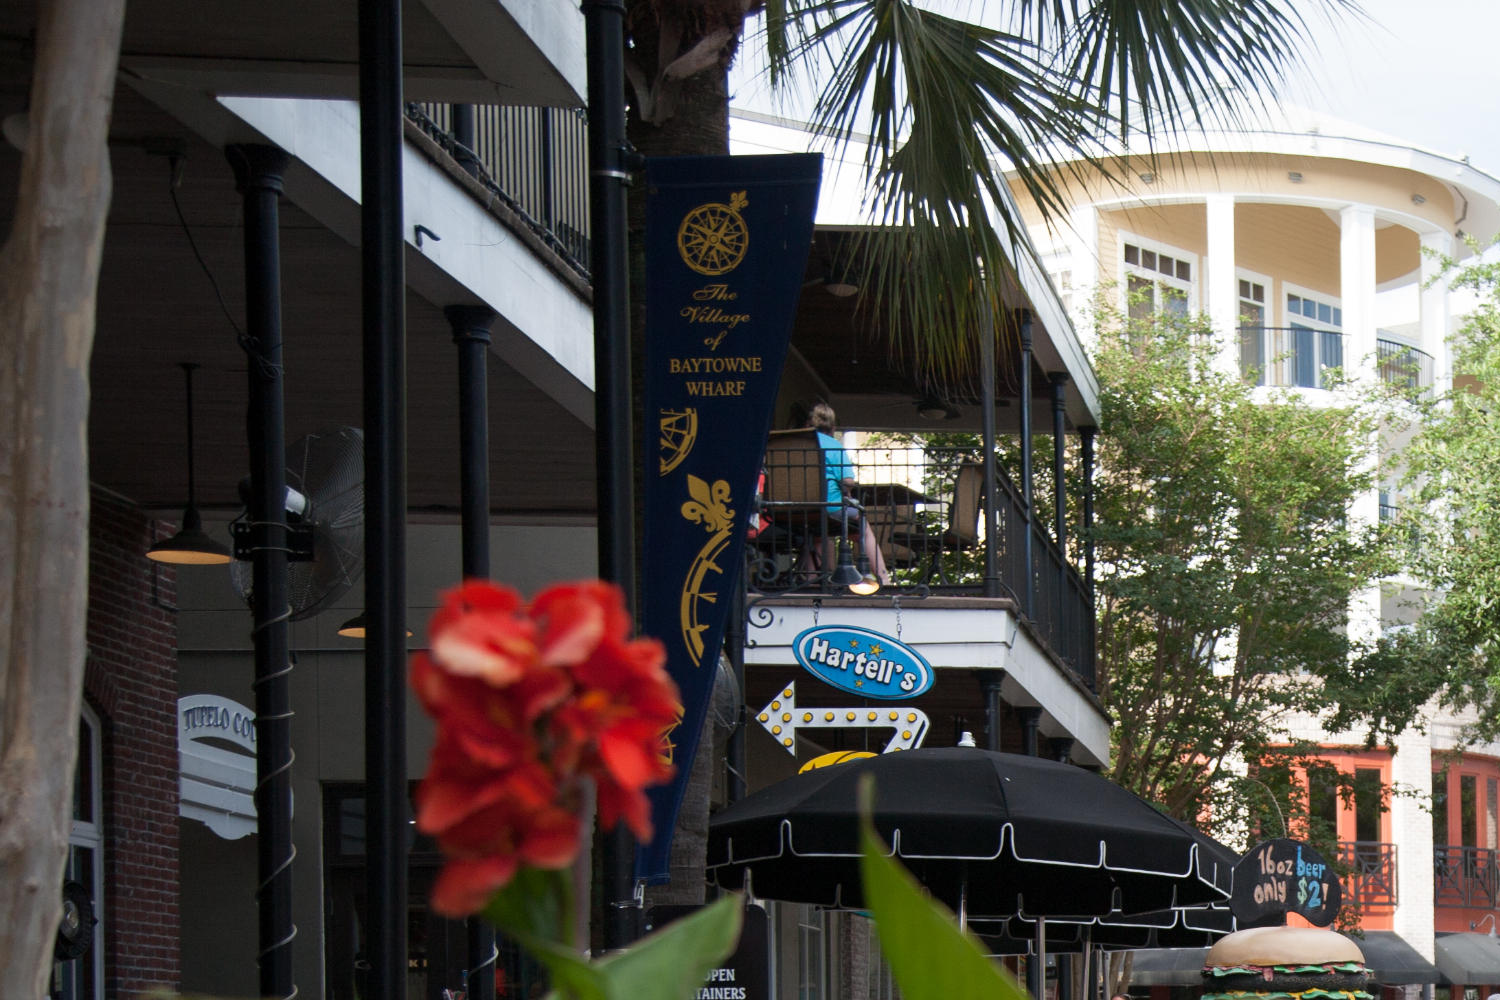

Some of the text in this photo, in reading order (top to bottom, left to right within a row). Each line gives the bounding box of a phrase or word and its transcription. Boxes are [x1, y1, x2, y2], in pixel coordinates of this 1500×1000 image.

[693, 284, 738, 301] The
[679, 306, 751, 329] Village
[703, 330, 728, 351] of
[670, 357, 762, 373] BAYTOWNE
[685, 381, 746, 397] WHARF
[809, 636, 917, 692] Hartell's
[184, 706, 231, 731] TUPELO
[1296, 845, 1326, 879] beer
[1254, 876, 1287, 904] only
[690, 987, 747, 1000] TAINERS
